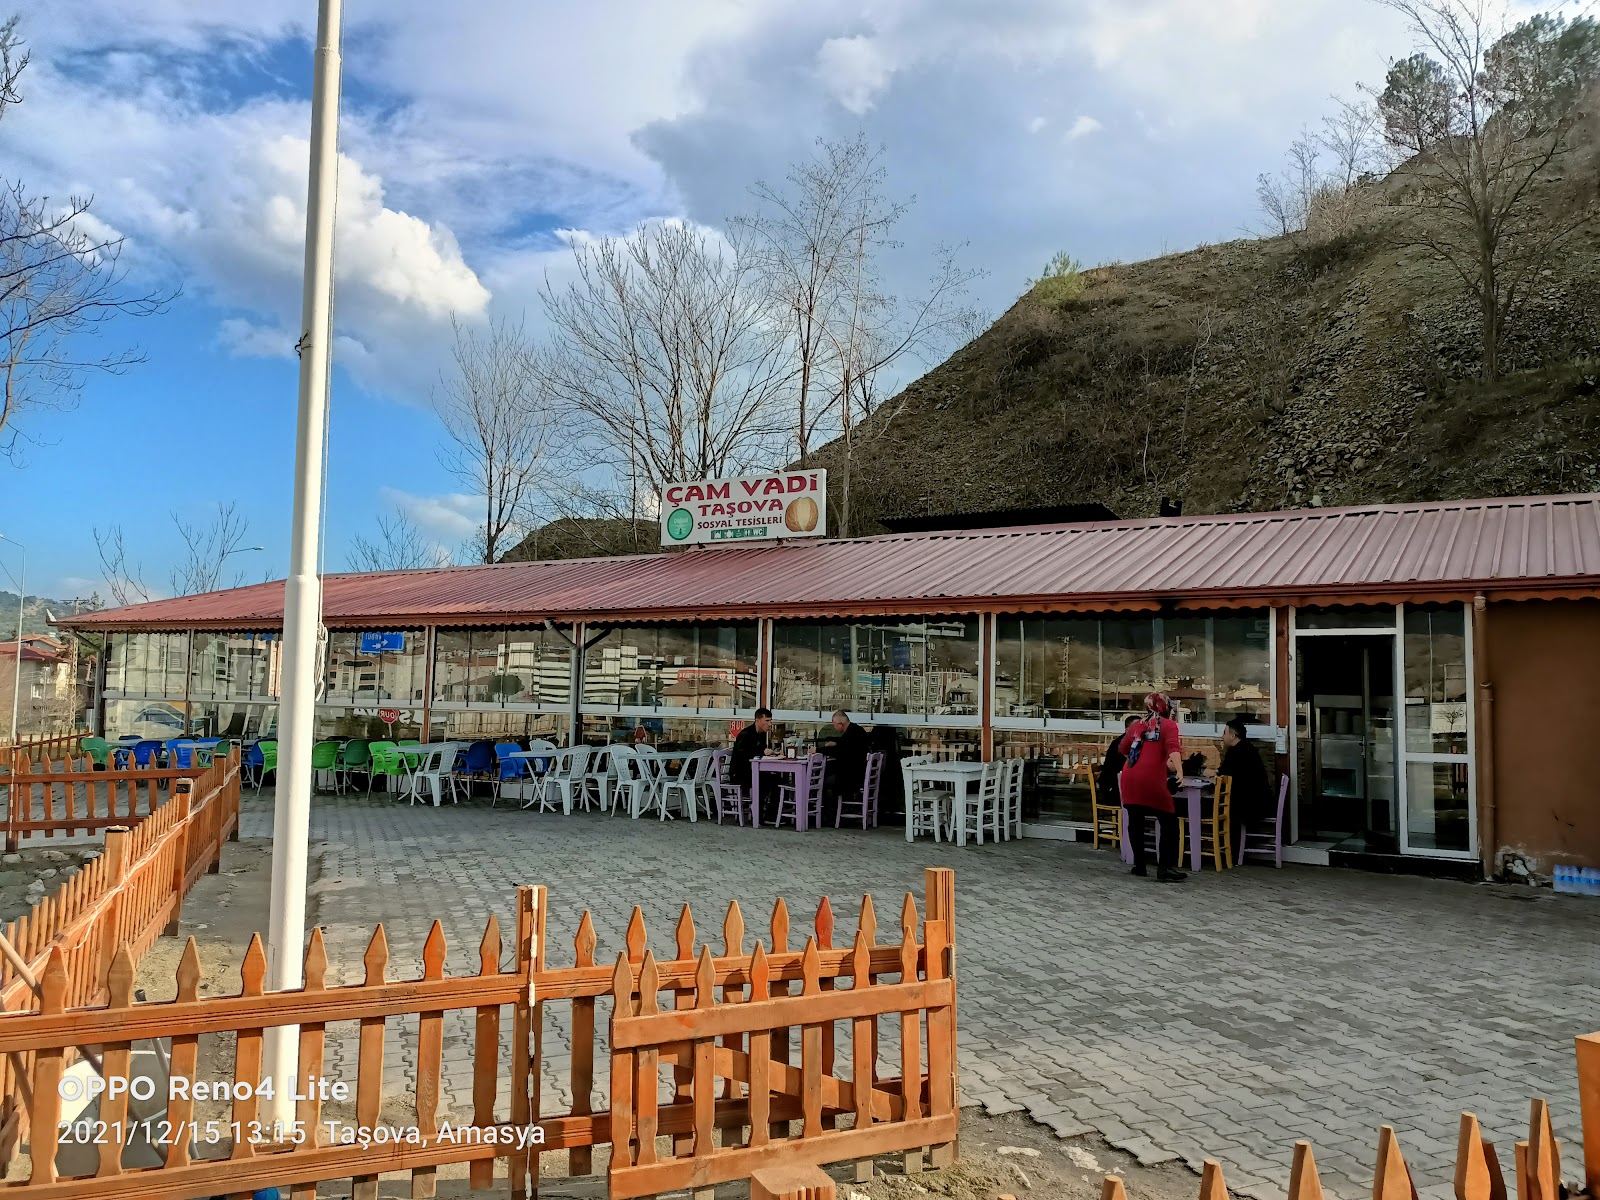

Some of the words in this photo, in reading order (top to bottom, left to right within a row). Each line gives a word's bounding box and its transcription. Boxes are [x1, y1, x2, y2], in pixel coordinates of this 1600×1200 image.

[666, 481, 731, 508] ÇAM
[739, 473, 818, 497] VADİ
[697, 498, 784, 518] TAŞOVA
[697, 519, 733, 530] SOSYAL
[735, 513, 783, 527] TESİSLERİ
[753, 528, 763, 536] WC
